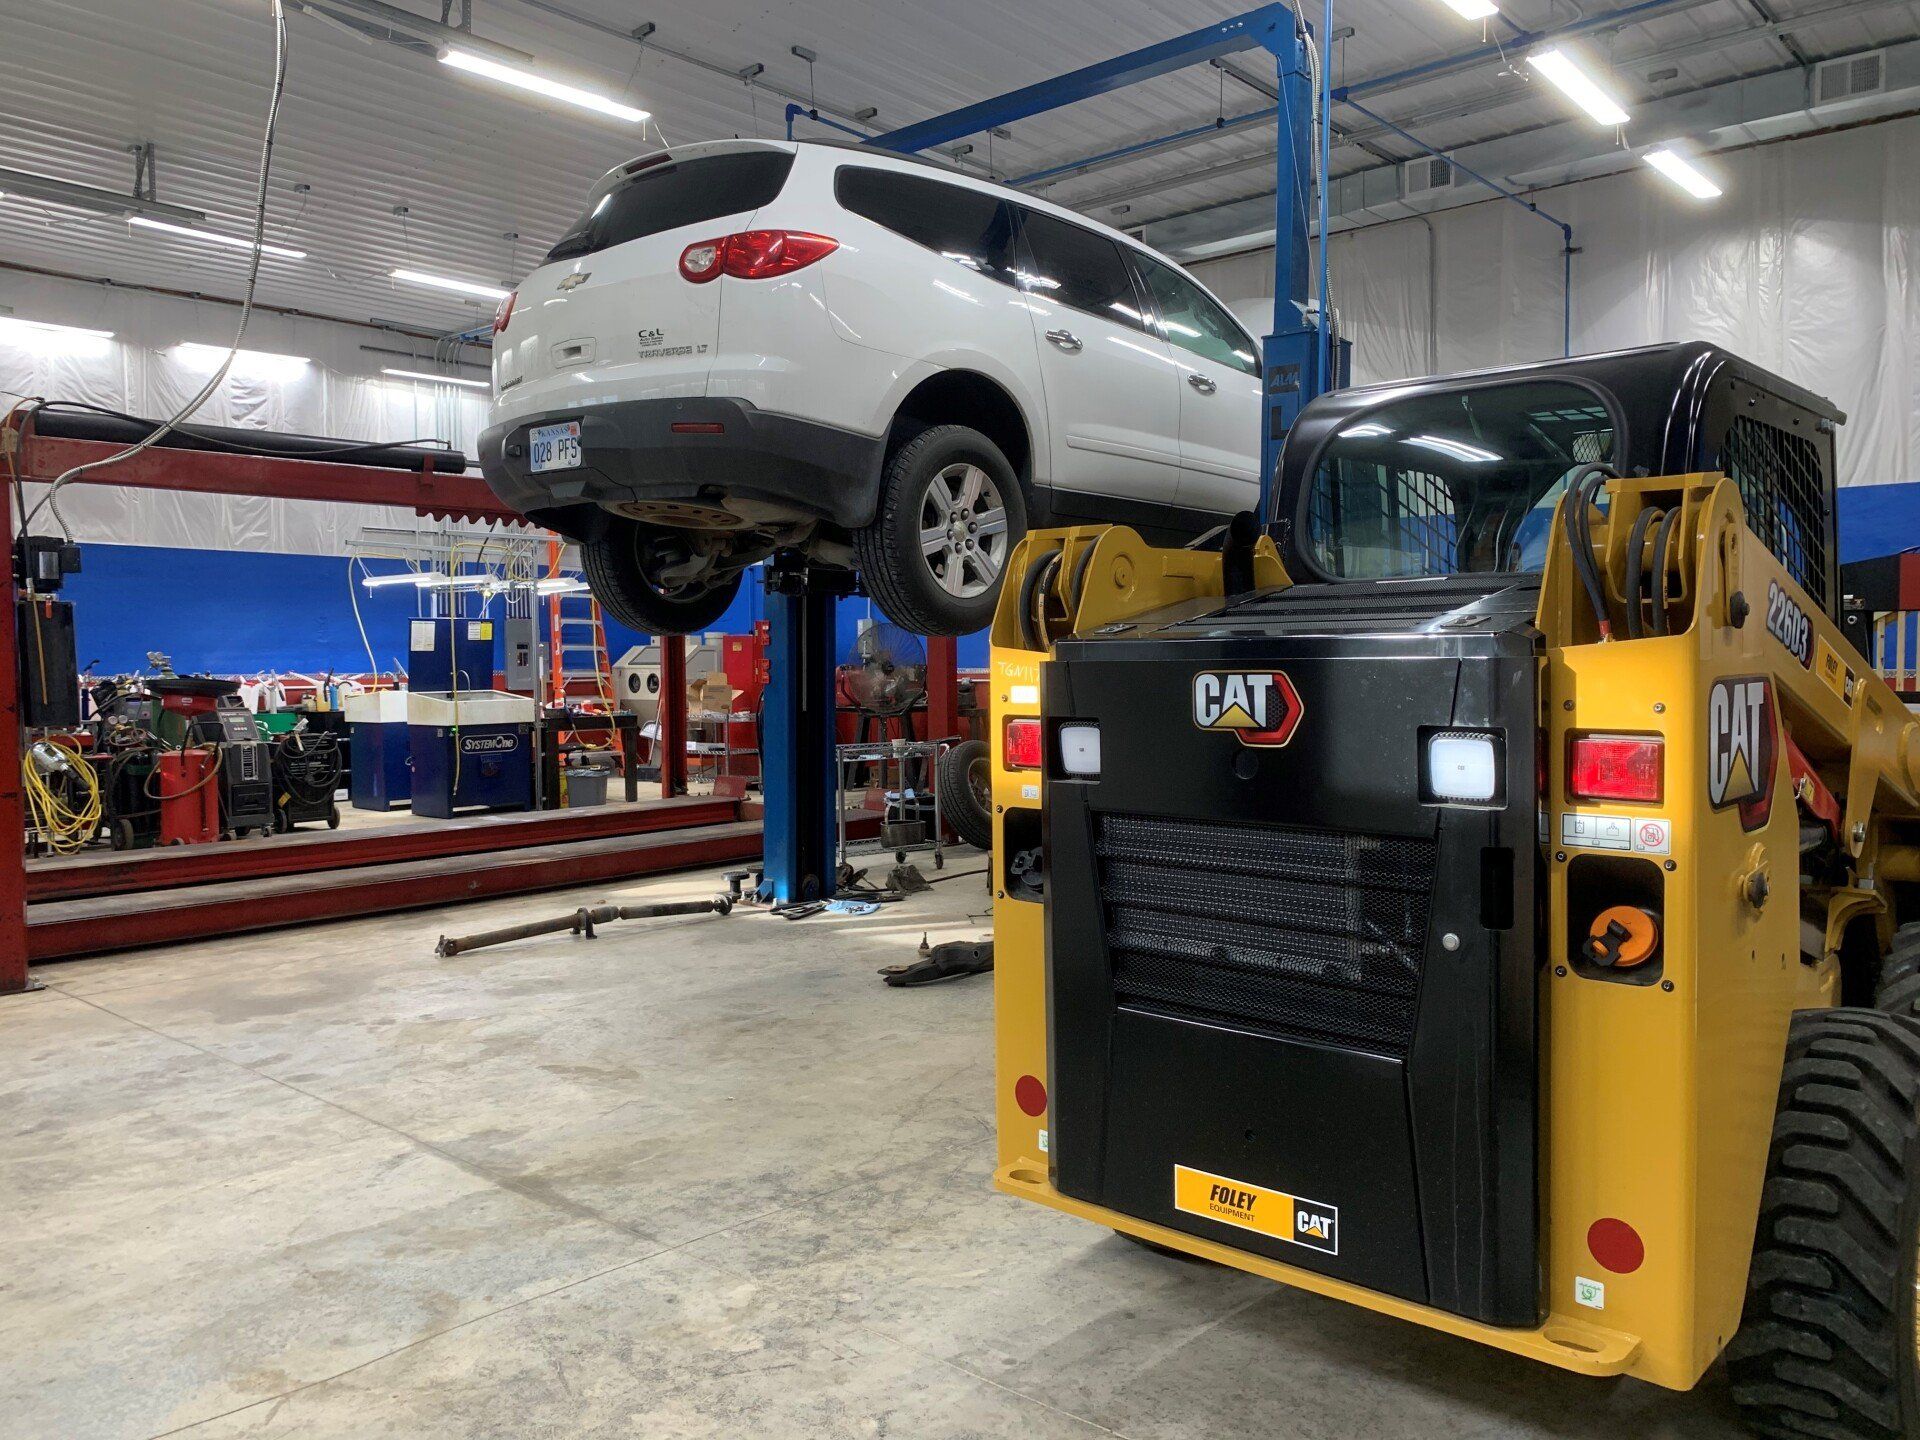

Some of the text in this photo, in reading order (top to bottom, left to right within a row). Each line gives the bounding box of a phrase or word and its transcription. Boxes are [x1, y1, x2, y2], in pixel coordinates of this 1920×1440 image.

[638, 346, 692, 358] TRAVERSE
[534, 437, 577, 463] 028 PFS
[1767, 582, 1809, 663] 226D3
[1195, 673, 1273, 728] CAT
[1710, 682, 1764, 804] CAT
[1210, 1184, 1257, 1211] FOLEY
[1209, 1203, 1255, 1222] EQUIPMENT
[1297, 1210, 1332, 1240] CAT
